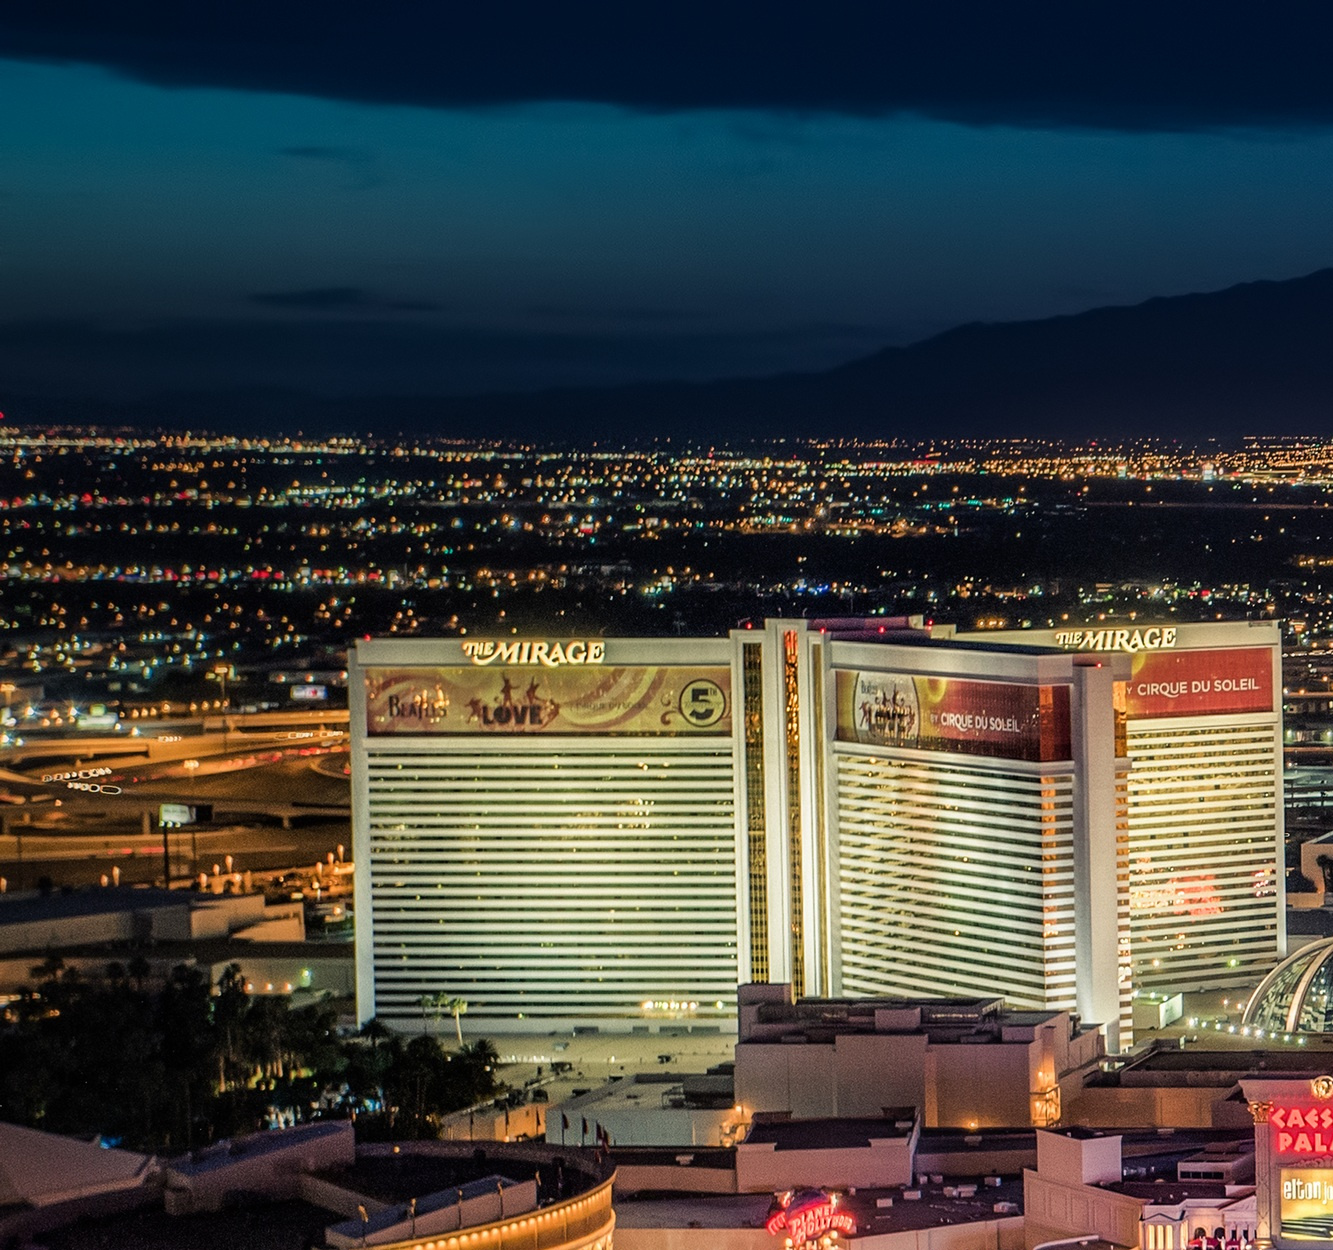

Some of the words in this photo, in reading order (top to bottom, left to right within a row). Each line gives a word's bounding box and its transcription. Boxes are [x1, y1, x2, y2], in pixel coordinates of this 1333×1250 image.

[462, 641, 494, 657] THE
[1055, 631, 1082, 646] THE
[1079, 627, 1177, 653] MIRAGE
[473, 641, 605, 667] MIRAGE
[1137, 681, 1188, 697] CIRQUE
[1191, 681, 1211, 693] DU
[1214, 678, 1259, 692] SOLEIL
[482, 704, 542, 726] LOVE
[940, 712, 973, 731] CIRQUE
[976, 714, 988, 730] DU
[989, 716, 1021, 733] SOLEIL
[1283, 1178, 1321, 1200] elton
[788, 1205, 835, 1237] PLANET
[795, 1214, 853, 1247] HOLLYWOOD
